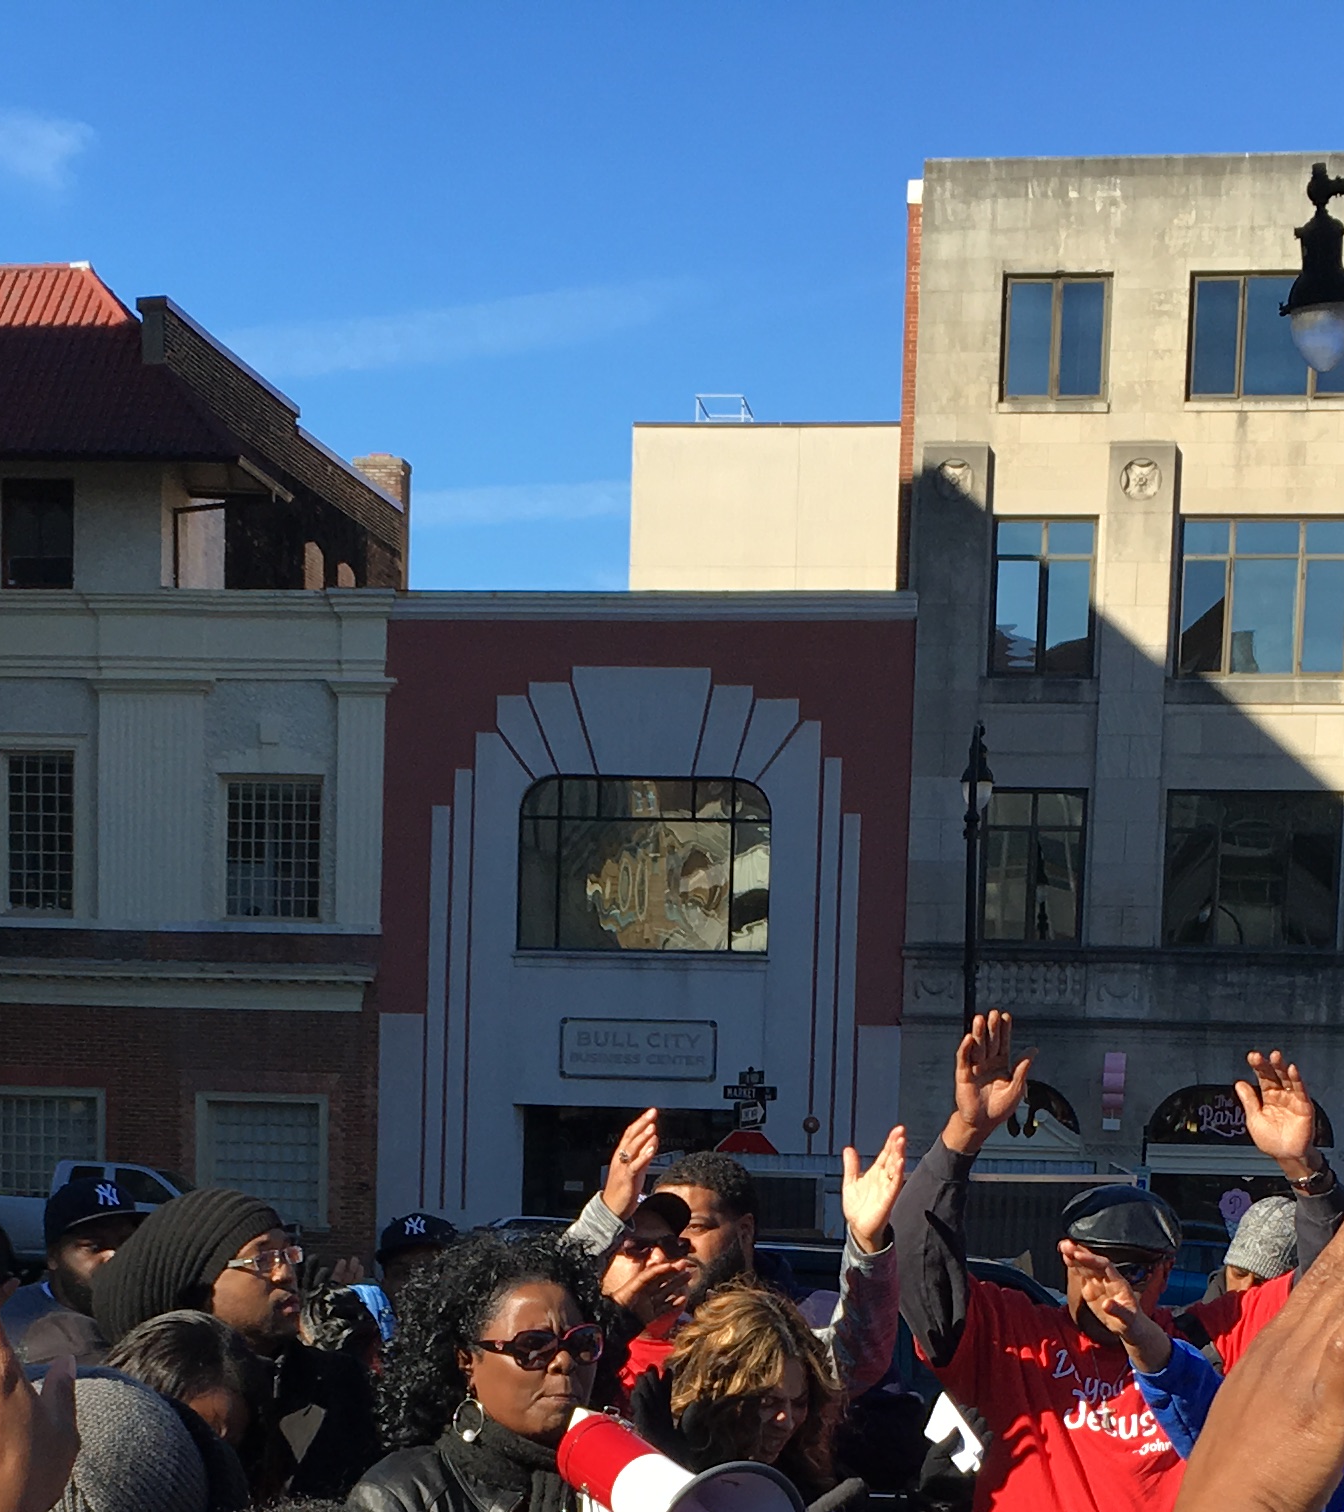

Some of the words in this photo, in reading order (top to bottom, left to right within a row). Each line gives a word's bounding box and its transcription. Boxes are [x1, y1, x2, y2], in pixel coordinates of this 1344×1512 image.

[576, 1031, 639, 1049] BULL
[646, 1032, 702, 1049] CITY
[569, 1052, 641, 1065] BUSINESS
[646, 1053, 706, 1067] CENTER
[726, 1087, 757, 1099] MARKET
[1214, 1095, 1234, 1109] The
[94, 1183, 121, 1206] NY
[404, 1216, 426, 1235] NY
[1083, 1376, 1125, 1405] you
